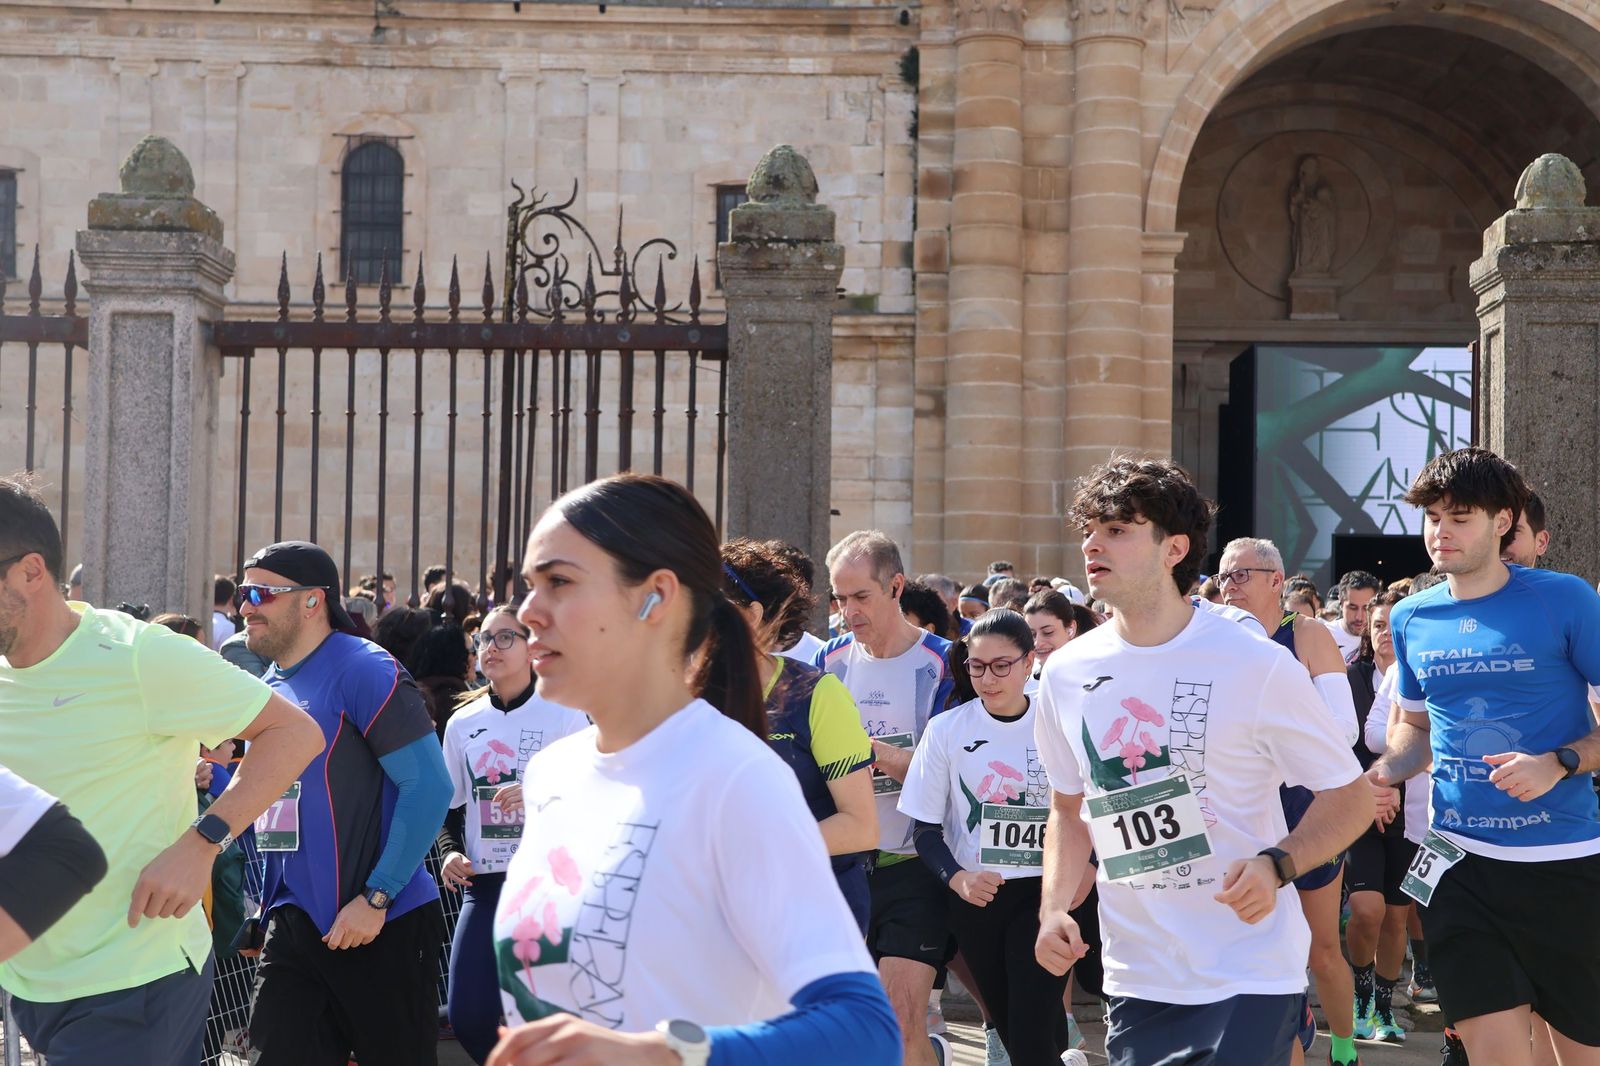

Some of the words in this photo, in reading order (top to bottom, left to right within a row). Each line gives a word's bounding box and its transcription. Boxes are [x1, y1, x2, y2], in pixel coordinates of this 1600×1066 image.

[1418, 648, 1483, 662] TRAIL
[1488, 643, 1526, 656] DA
[1416, 658, 1535, 680] AMIZADE
[1113, 804, 1181, 851] 103
